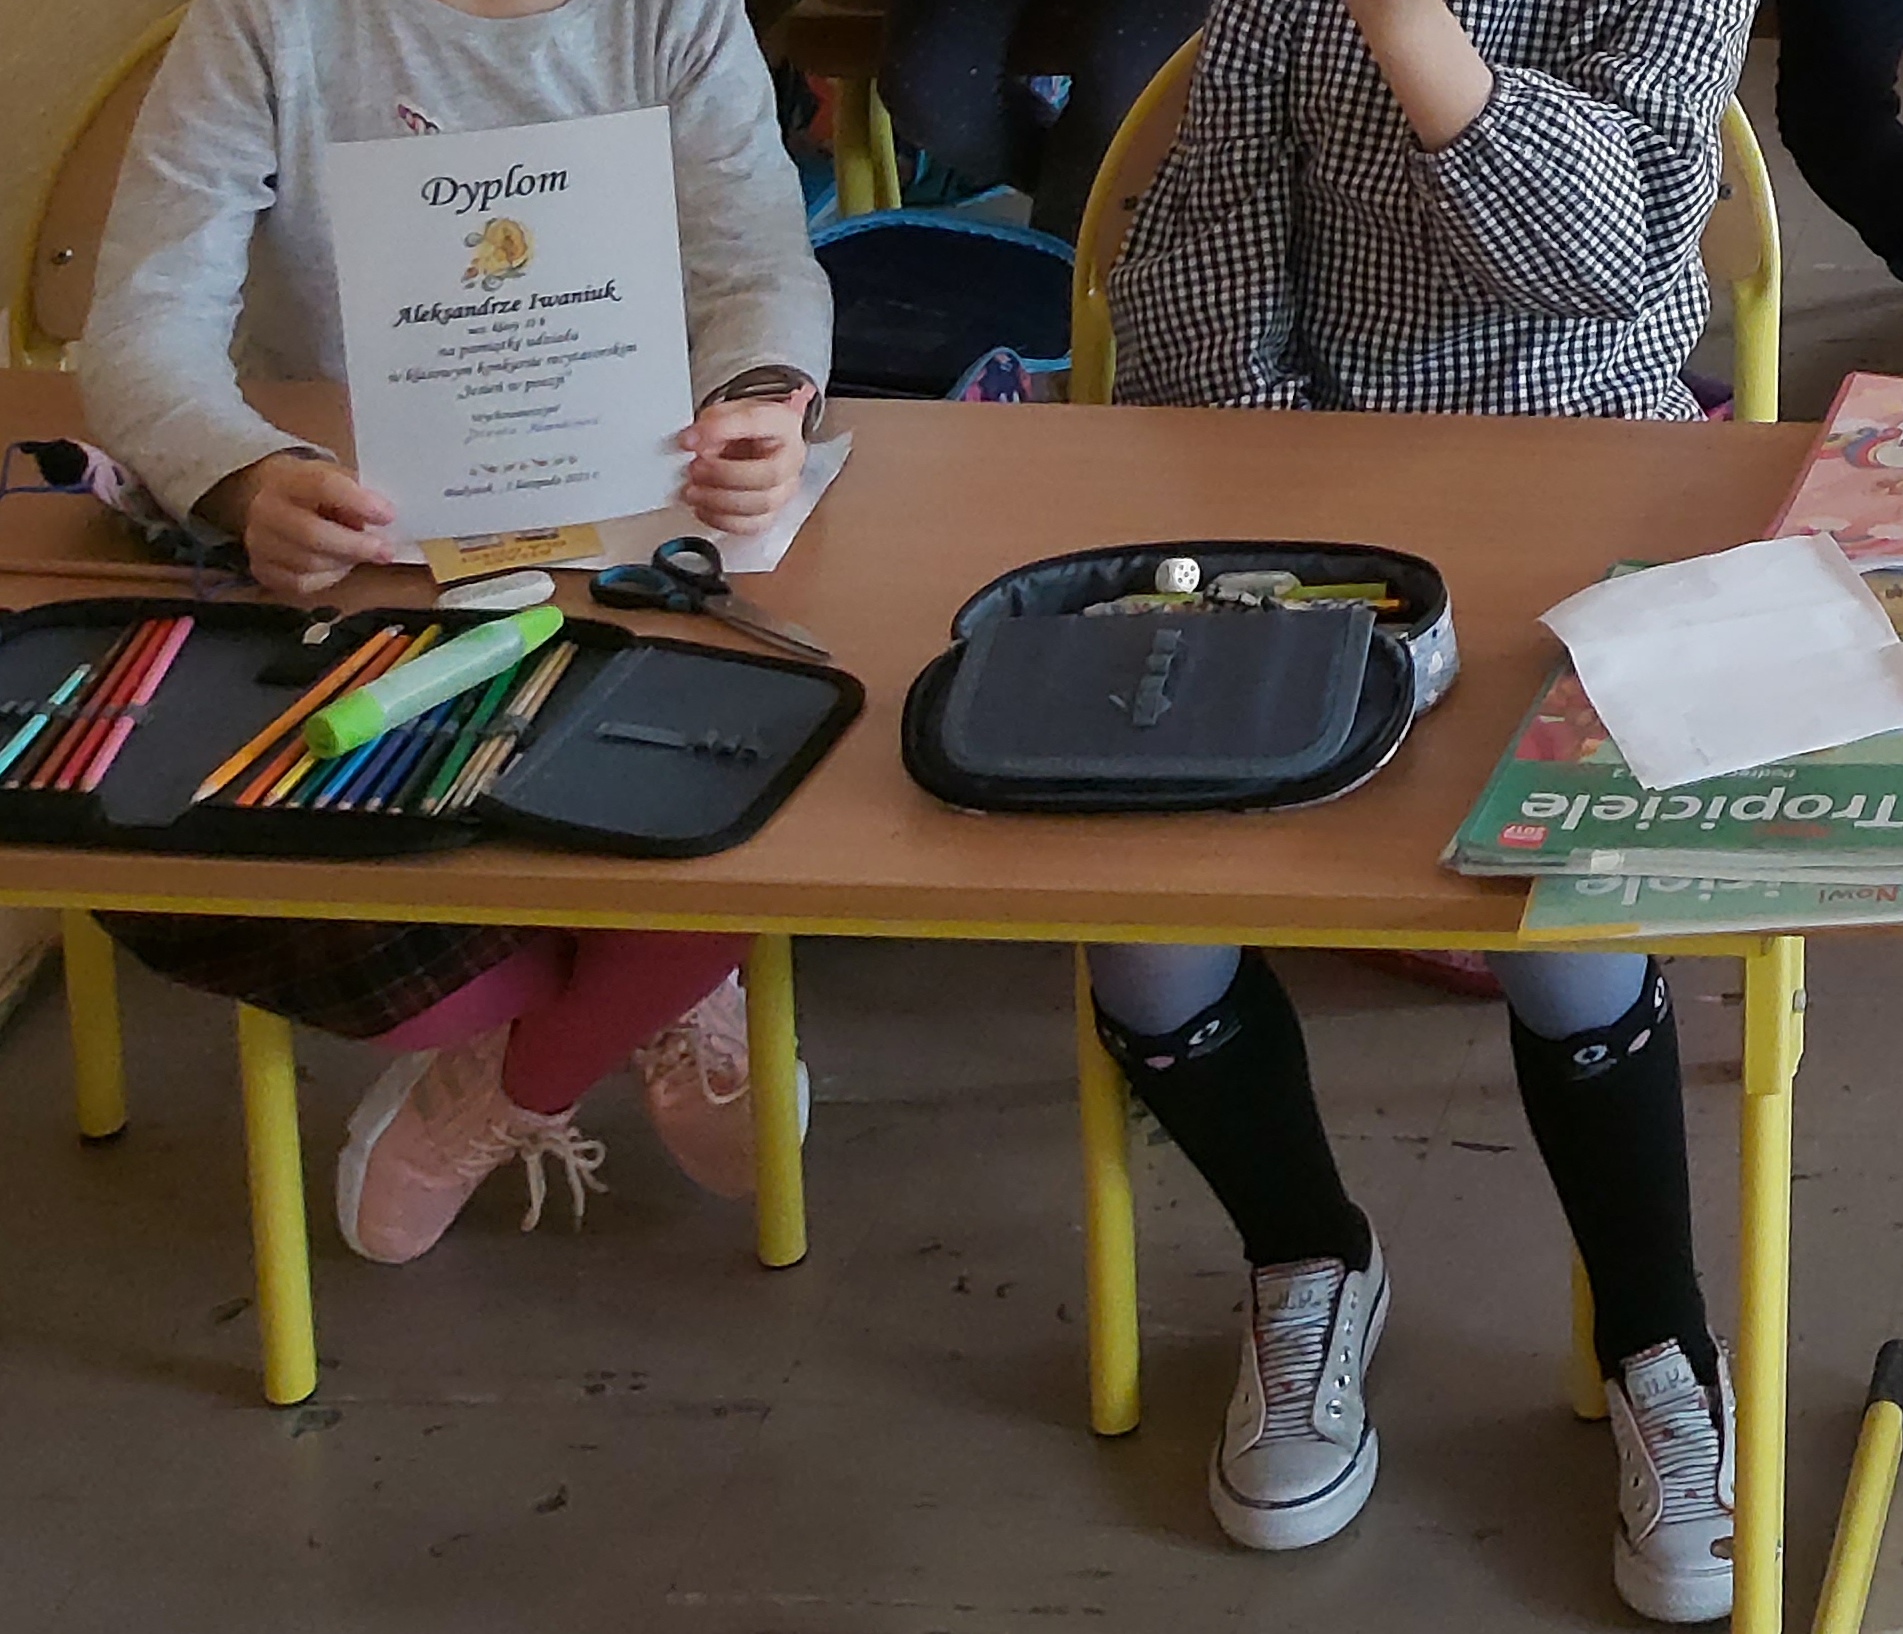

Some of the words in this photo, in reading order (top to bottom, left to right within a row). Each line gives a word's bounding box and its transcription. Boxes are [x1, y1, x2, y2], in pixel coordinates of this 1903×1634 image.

[421, 163, 570, 215] Dyplom
[392, 295, 522, 328] Aleksandrze
[527, 278, 624, 311] Iwaniuk
